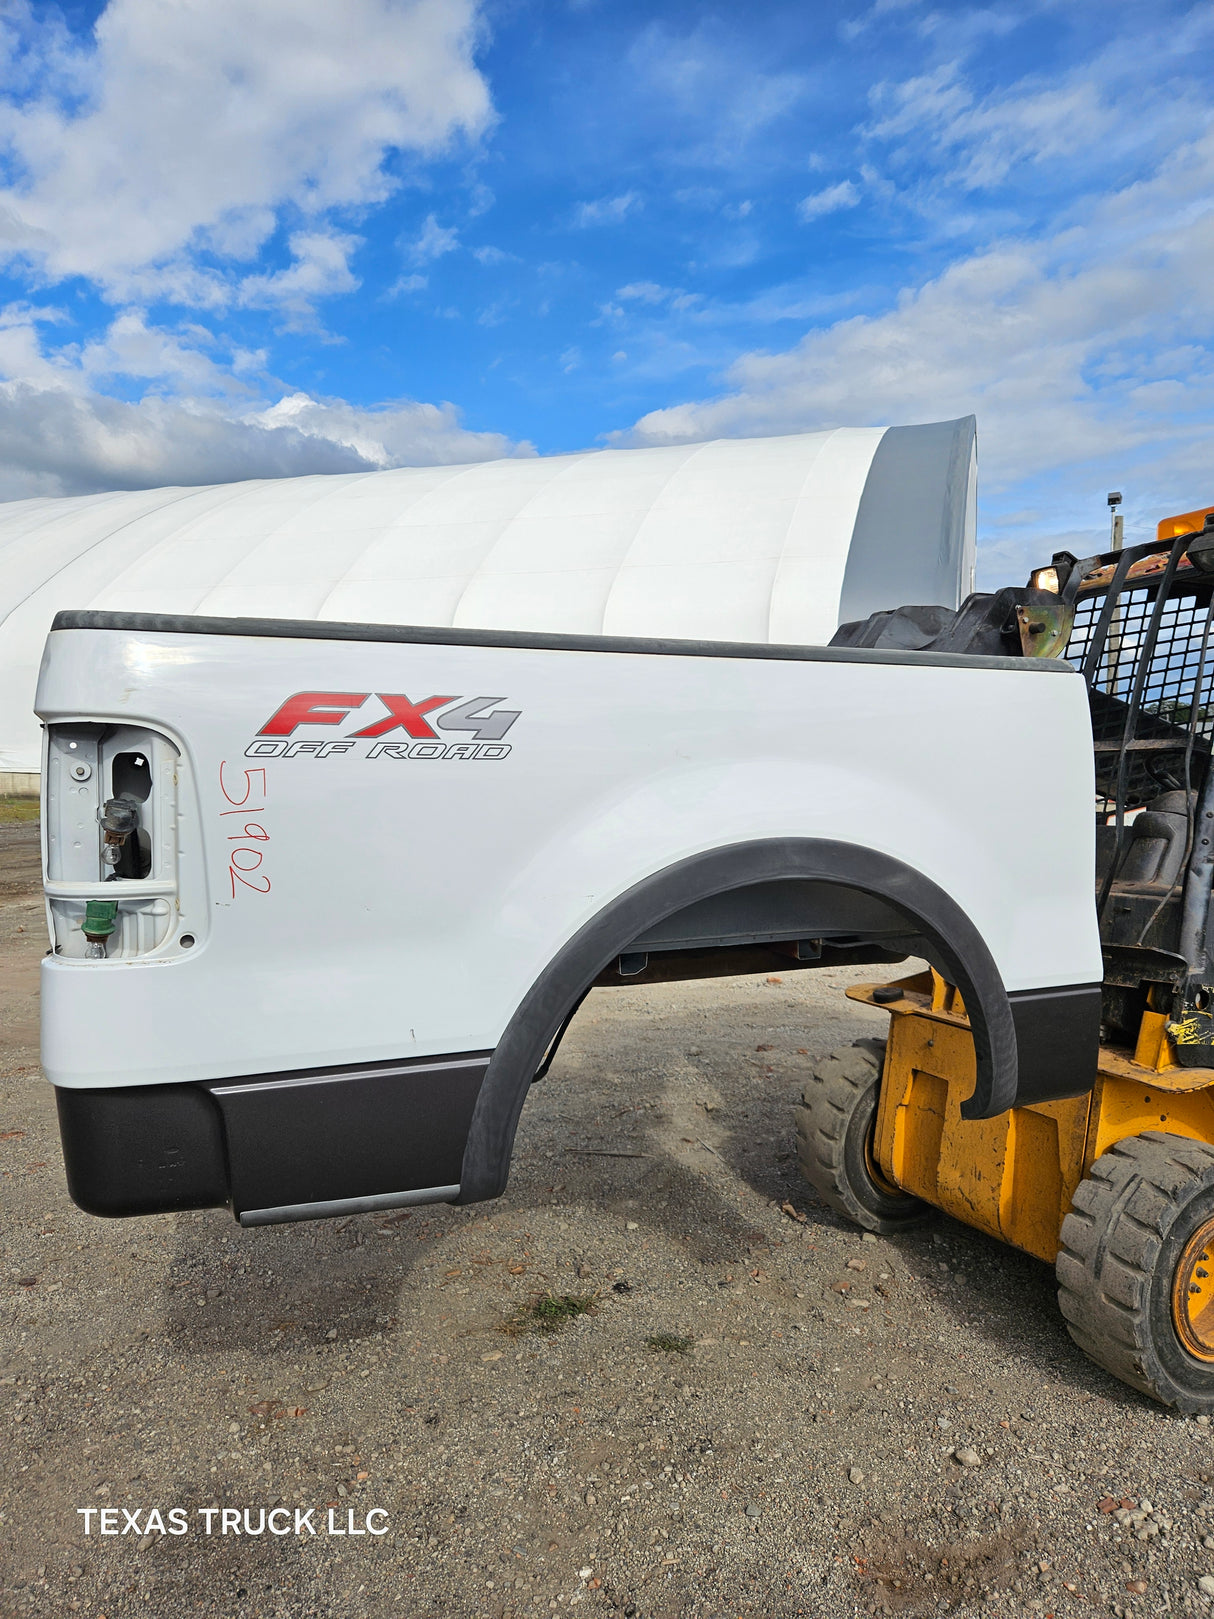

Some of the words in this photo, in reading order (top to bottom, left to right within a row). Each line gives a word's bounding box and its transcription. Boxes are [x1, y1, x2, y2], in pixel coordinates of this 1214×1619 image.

[255, 690, 522, 740] FX4
[244, 740, 356, 758] OFF
[365, 741, 513, 760] ROAD
[219, 760, 271, 899] 51902
